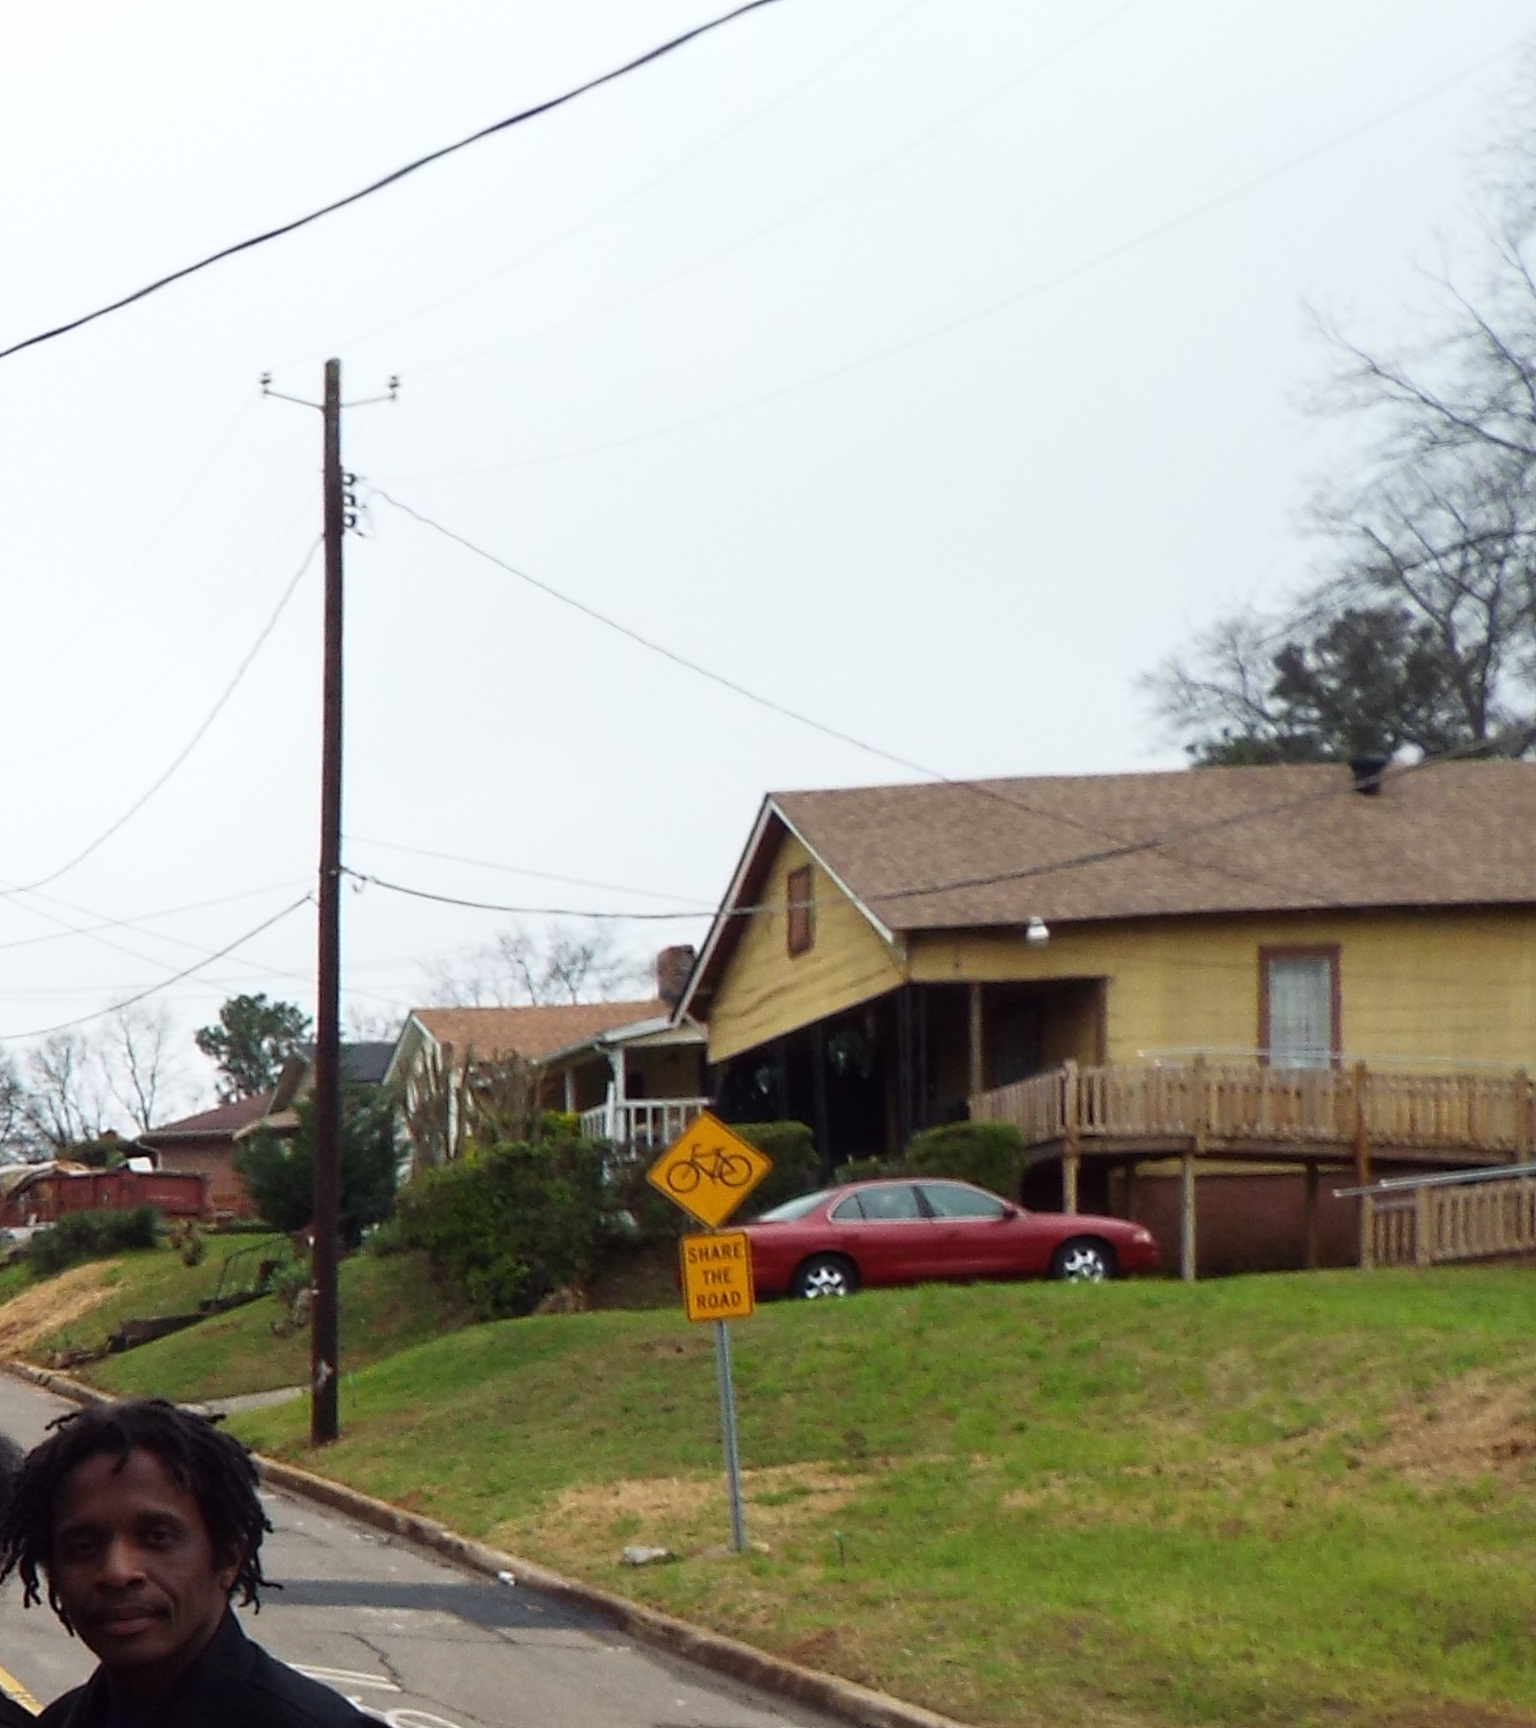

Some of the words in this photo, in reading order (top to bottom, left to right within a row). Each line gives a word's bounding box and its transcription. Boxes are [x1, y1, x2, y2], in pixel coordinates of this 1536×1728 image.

[689, 1243, 740, 1263] SHARE
[703, 1267, 731, 1285] THE
[696, 1291, 741, 1310] ROAD
